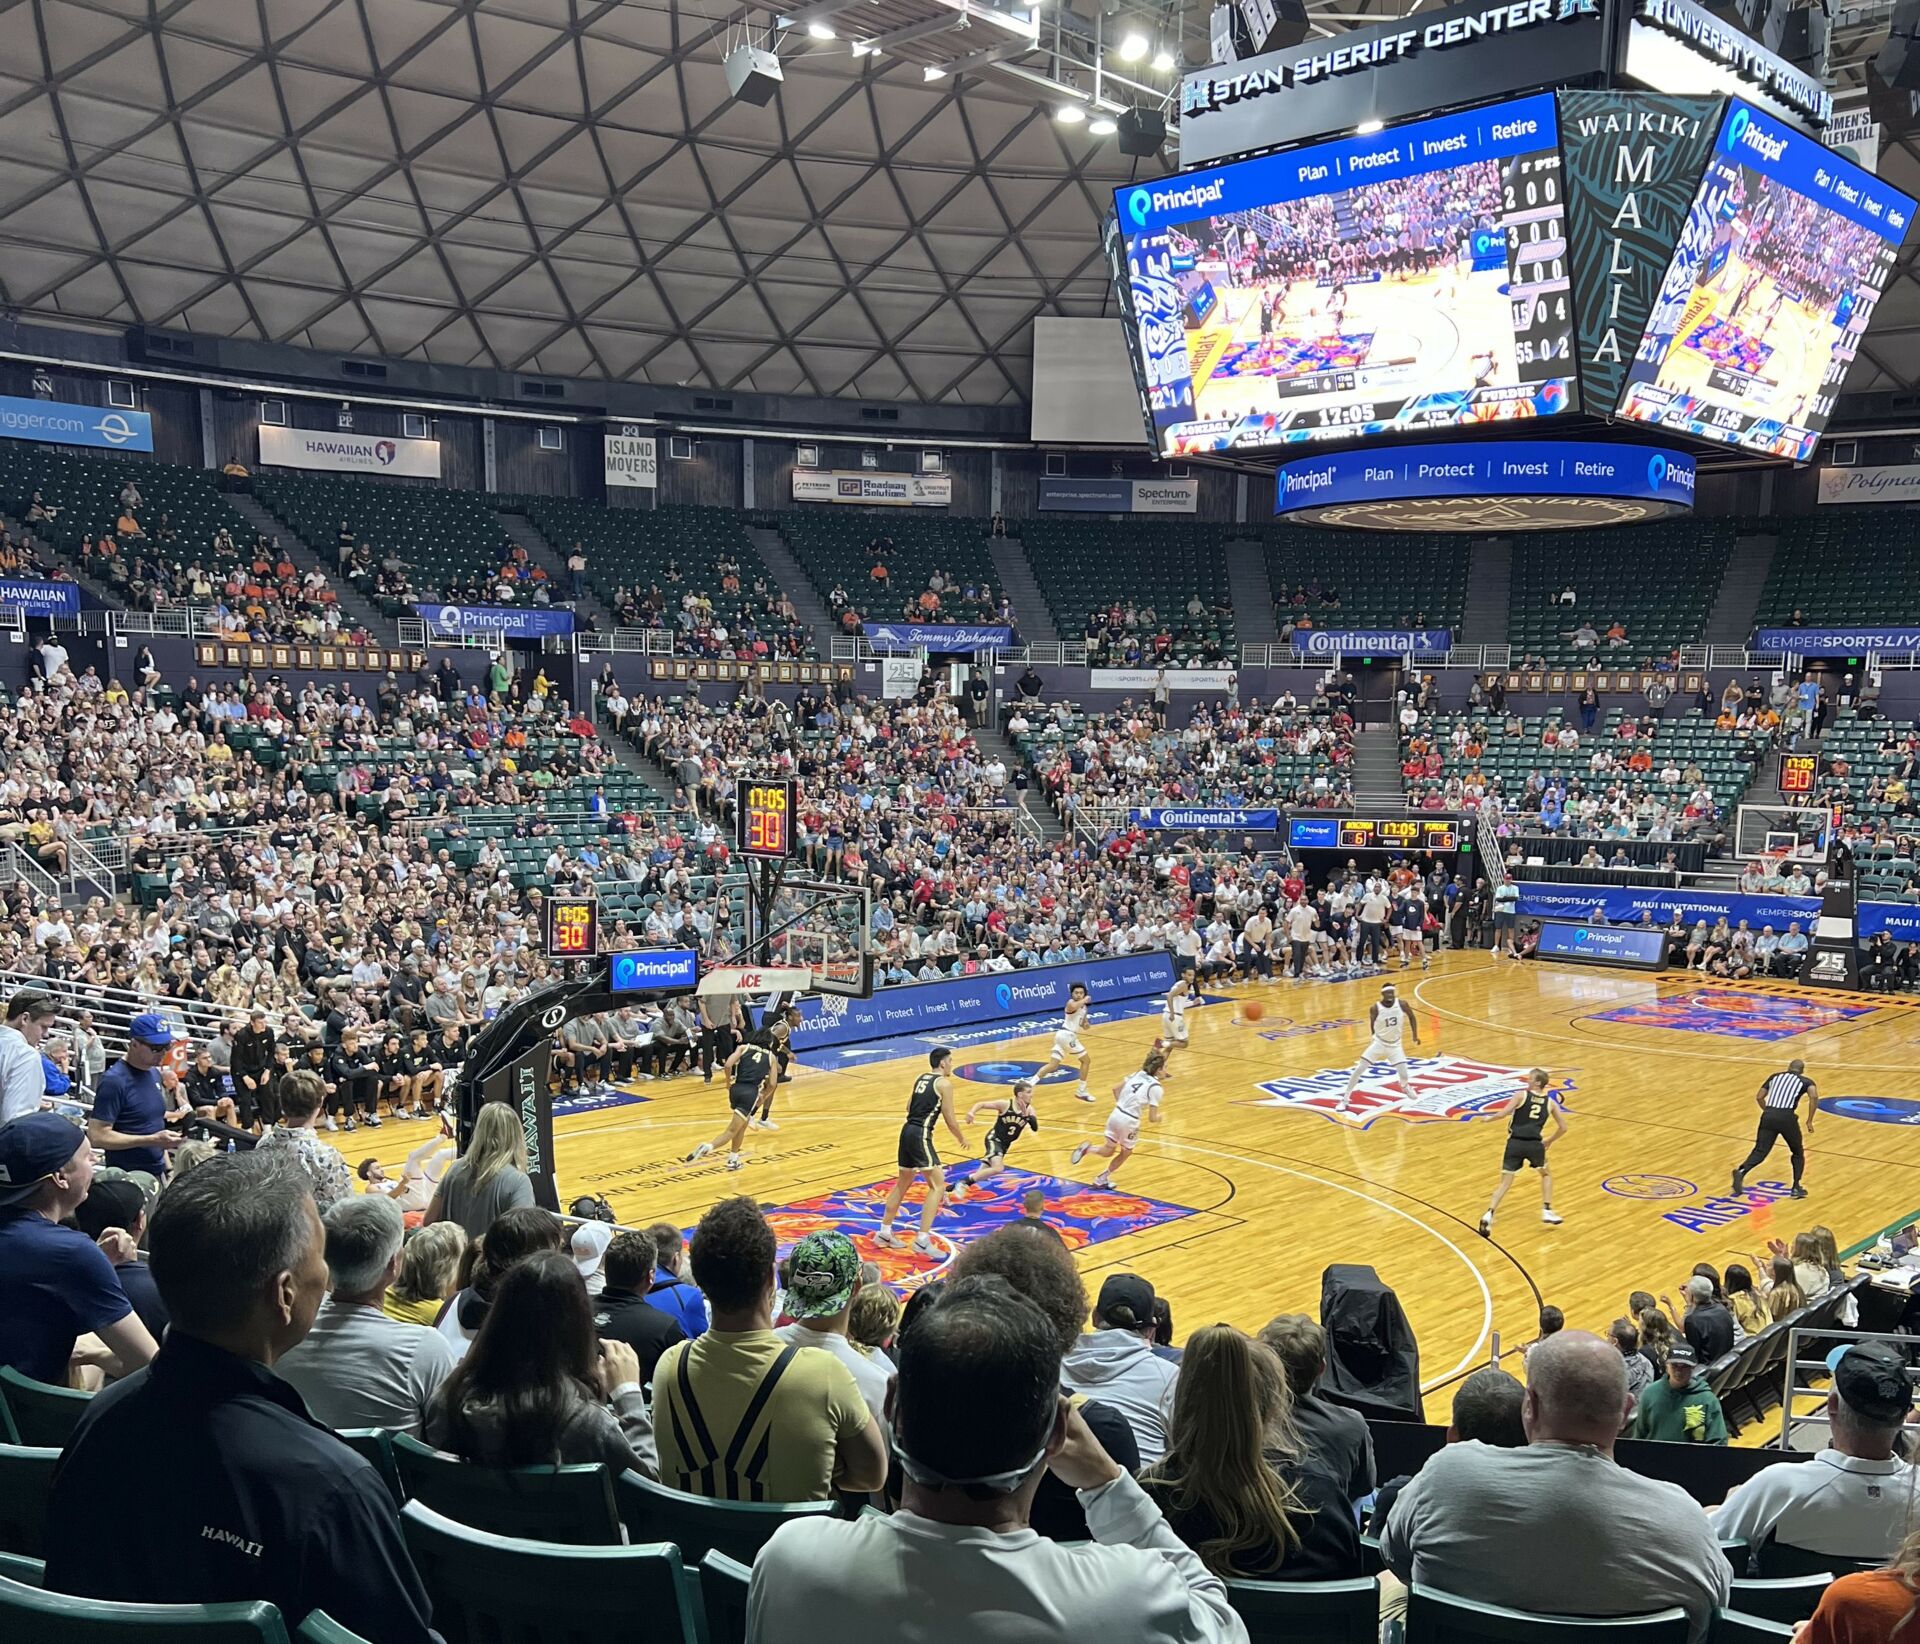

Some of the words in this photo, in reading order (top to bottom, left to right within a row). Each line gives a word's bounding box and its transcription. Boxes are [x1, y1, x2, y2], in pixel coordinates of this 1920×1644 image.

[1666, 3, 1752, 68] UNIVERSITY
[1754, 57, 1774, 81] OF
[1212, 65, 1284, 102] STAN
[1294, 30, 1418, 83] SHERIFF
[1424, 0, 1553, 48] CENTER
[1578, 112, 1700, 139] WAIKIKI
[1826, 111, 1870, 132] OMEN'S
[1742, 122, 1787, 161] Principal
[1298, 165, 1328, 183] Plan
[1349, 148, 1400, 172] Protect
[1423, 133, 1468, 156] Invest
[1492, 118, 1538, 141] Retire
[1504, 186, 1516, 212] 2
[1526, 181, 1537, 206] 0
[1545, 177, 1556, 202] 0
[1814, 168, 1831, 188] Plan
[1835, 180, 1859, 204] Protect
[1153, 178, 1224, 212] Principal
[1508, 226, 1520, 249] 3
[1530, 222, 1541, 245] 0
[1549, 218, 1559, 241] 0
[1592, 145, 1656, 362] MALIA
[1512, 264, 1523, 286] 4
[1533, 261, 1544, 284] 0
[1551, 259, 1562, 281] 0
[1512, 303, 1530, 326] 15
[1537, 300, 1548, 323] 0
[1555, 297, 1566, 321] 4
[1516, 342, 1533, 364] 55
[1540, 338, 1551, 361] 0
[1558, 336, 1570, 359] 2
[1481, 386, 1536, 402] PURDUE
[0, 408, 84, 433] igger.com
[338, 415, 353, 427] PP
[1319, 404, 1375, 426] 17:05
[1711, 408, 1743, 431] 17:05
[622, 425, 640, 436] QQ
[1180, 422, 1230, 436] GONZAGA
[306, 441, 372, 457] HAWAIIAN
[609, 440, 652, 457] ISLAND
[339, 456, 374, 465] AIRLINES
[607, 456, 656, 474] MOVERS
[863, 456, 877, 467] RR
[1287, 467, 1333, 492] Principal
[1364, 467, 1394, 482] Plan
[1418, 461, 1475, 478] Protect
[1503, 460, 1548, 476] Invest
[1574, 461, 1614, 477] Retire
[841, 482, 859, 492] GP
[864, 480, 907, 492] Roadway
[864, 488, 907, 498] Solutions
[1138, 488, 1187, 500] Spectrum
[1, 586, 66, 602] HAWAIIAN
[17, 600, 51, 609] AIRLINES
[464, 611, 525, 629] Principal
[908, 629, 951, 647] Tommy
[951, 630, 1004, 643] Bahama
[1308, 632, 1415, 654] Continental
[890, 663, 914, 679] 25
[1787, 758, 1815, 769] 17:05
[1787, 769, 1810, 788] 30
[749, 787, 785, 810] 17:05
[1160, 810, 1236, 827] Continental
[751, 811, 780, 848] 30
[1384, 823, 1416, 836] 17:05
[1424, 823, 1449, 831] PURDUE
[1355, 833, 1364, 845] 6
[1442, 834, 1452, 846] 6
[1519, 894, 1607, 906] EMPERSPORTSLIVE
[1632, 901, 1659, 909] MAUI
[1661, 902, 1730, 913] INVITATIONAL
[556, 906, 589, 924] 17:05
[1885, 917, 1912, 927] MAUI
[559, 926, 582, 948] 30
[1588, 933, 1622, 943] Principal
[1575, 945, 1594, 953] Protect
[1816, 951, 1846, 970] 25
[636, 961, 688, 978] Principal
[736, 974, 762, 988] ACE
[1011, 980, 1055, 1001] Principal
[1091, 978, 1114, 989] Protect
[1122, 974, 1142, 984] Invest
[1149, 970, 1168, 980] Retire
[855, 1012, 874, 1025] Plan
[885, 1006, 914, 1020] Protect
[925, 1001, 948, 1014] Invest
[958, 997, 981, 1009] Retire
[1385, 1017, 1398, 1027] 13
[172, 1046, 185, 1060] G
[751, 1052, 762, 1064] 4
[915, 1080, 928, 1093] 15
[1131, 1082, 1144, 1094] 4
[1529, 1105, 1541, 1119] 2
[1008, 1126, 1017, 1136] 3
[744, 1142, 841, 1166] CENTER
